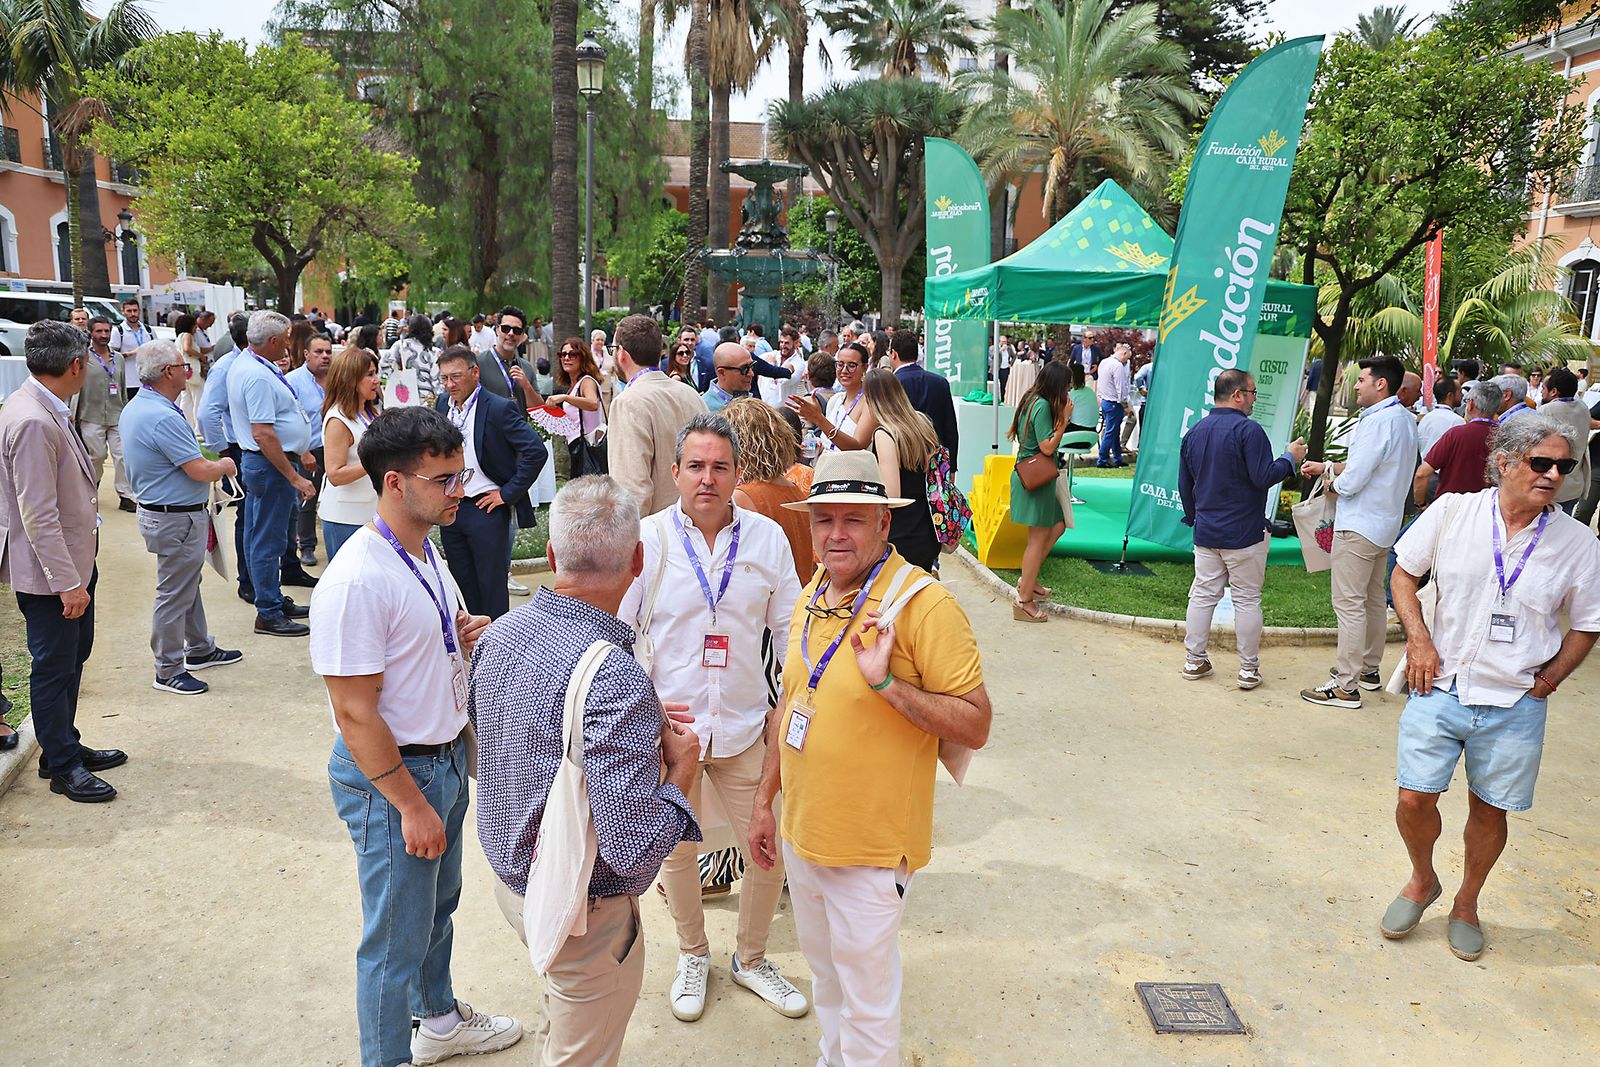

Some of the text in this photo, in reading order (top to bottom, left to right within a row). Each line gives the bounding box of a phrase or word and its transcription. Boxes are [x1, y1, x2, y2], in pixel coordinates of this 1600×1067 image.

[1206, 141, 1261, 157] Fundación
[1236, 156, 1289, 167] CAJA RURAL
[1140, 482, 1168, 500] CAJA
[1157, 498, 1174, 509] DEL
